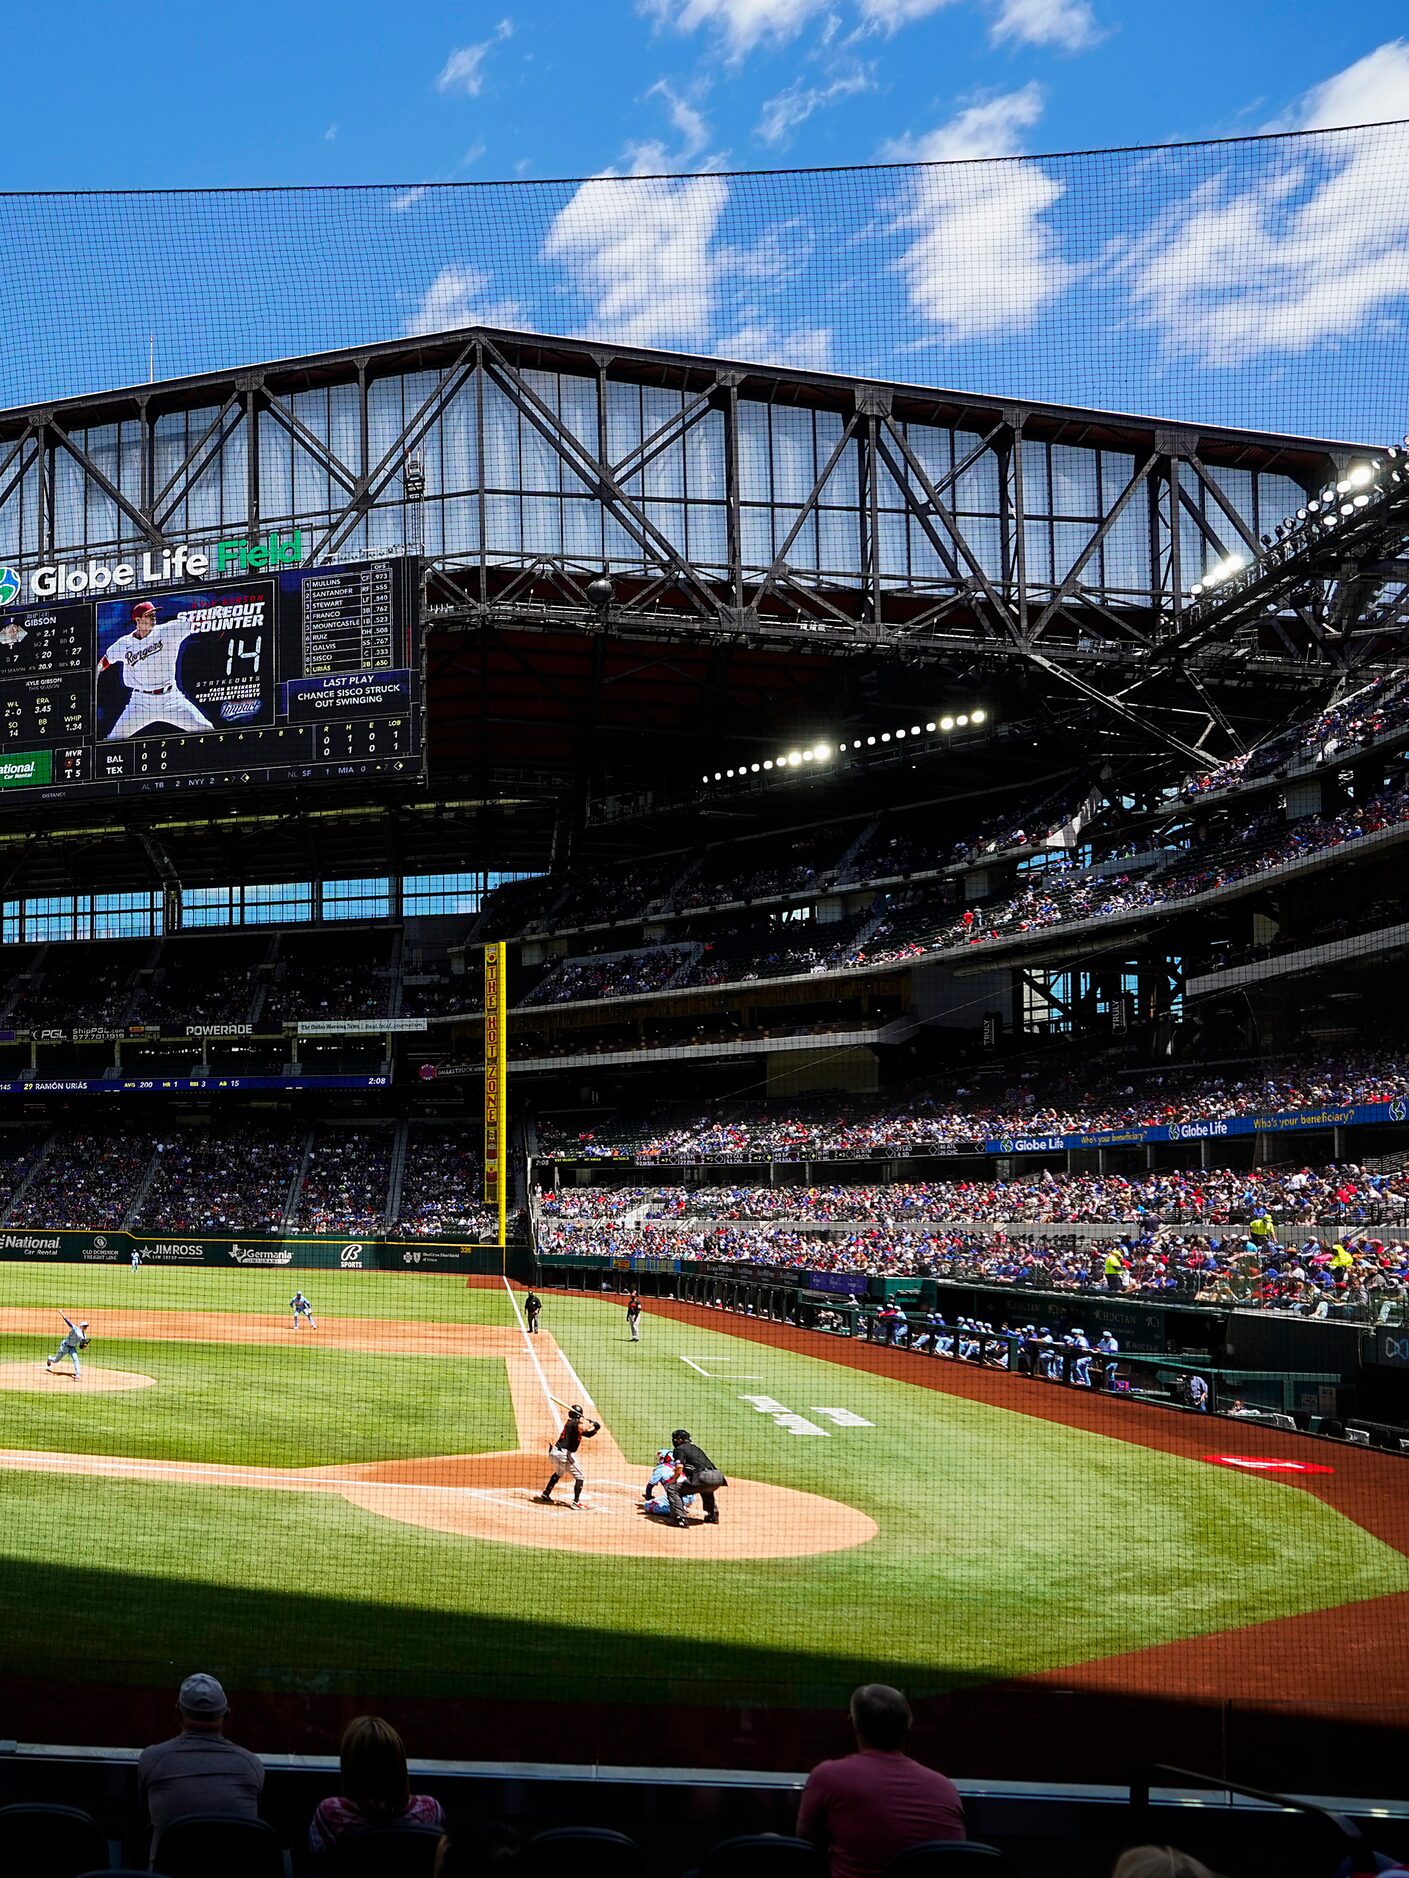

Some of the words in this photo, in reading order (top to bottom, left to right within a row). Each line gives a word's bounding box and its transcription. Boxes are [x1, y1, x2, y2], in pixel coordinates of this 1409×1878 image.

[31, 560, 133, 596] Globe
[143, 546, 208, 582] Life
[217, 530, 302, 571] Field
[313, 579, 340, 587] MULLINS
[313, 589, 352, 598] SANTANDER
[313, 600, 343, 608] STEWART
[177, 602, 265, 622] STRIKEOUT
[313, 611, 340, 619] FRANCO
[25, 617, 56, 626] GIBSON
[191, 614, 264, 633] COUNTER
[313, 620, 359, 630] MOUNTCASTLE
[44, 629, 55, 637] 2.1
[72, 647, 82, 655] 27
[125, 639, 163, 666] Rangers
[313, 643, 336, 651] GALVIS
[226, 636, 261, 676] 14
[196, 676, 260, 688] STRIKEOUTS
[323, 677, 347, 687] LAST
[349, 676, 374, 685] PLAY
[298, 691, 334, 700] CHANCE
[337, 688, 363, 697] SISCO
[365, 684, 400, 694] STRUCK
[315, 700, 334, 708] OUT
[336, 695, 382, 706] SWINGING
[35, 705, 51, 713] 3.45
[66, 723, 82, 731] 1.34
[107, 755, 123, 763] BAL
[106, 766, 123, 774] TEX
[487, 966, 497, 1009] THE
[42, 1030, 64, 1038] PGL
[187, 1025, 252, 1035] POWERADE
[487, 1015, 497, 1059] HOT
[487, 1066, 498, 1122] ZONE
[1253, 1118, 1277, 1129] Who's
[1280, 1118, 1298, 1128] your
[1300, 1110, 1355, 1125] beneficiary?
[1182, 1125, 1208, 1137] Globe
[1210, 1122, 1227, 1134] Life
[1081, 1136, 1095, 1144] Who's
[1098, 1136, 1110, 1145] your
[1112, 1131, 1147, 1144] beneficiary?
[1015, 1139, 1046, 1150] Globe
[1049, 1138, 1064, 1149] Life
[5, 1236, 60, 1248] National
[244, 1250, 292, 1259] Germania
